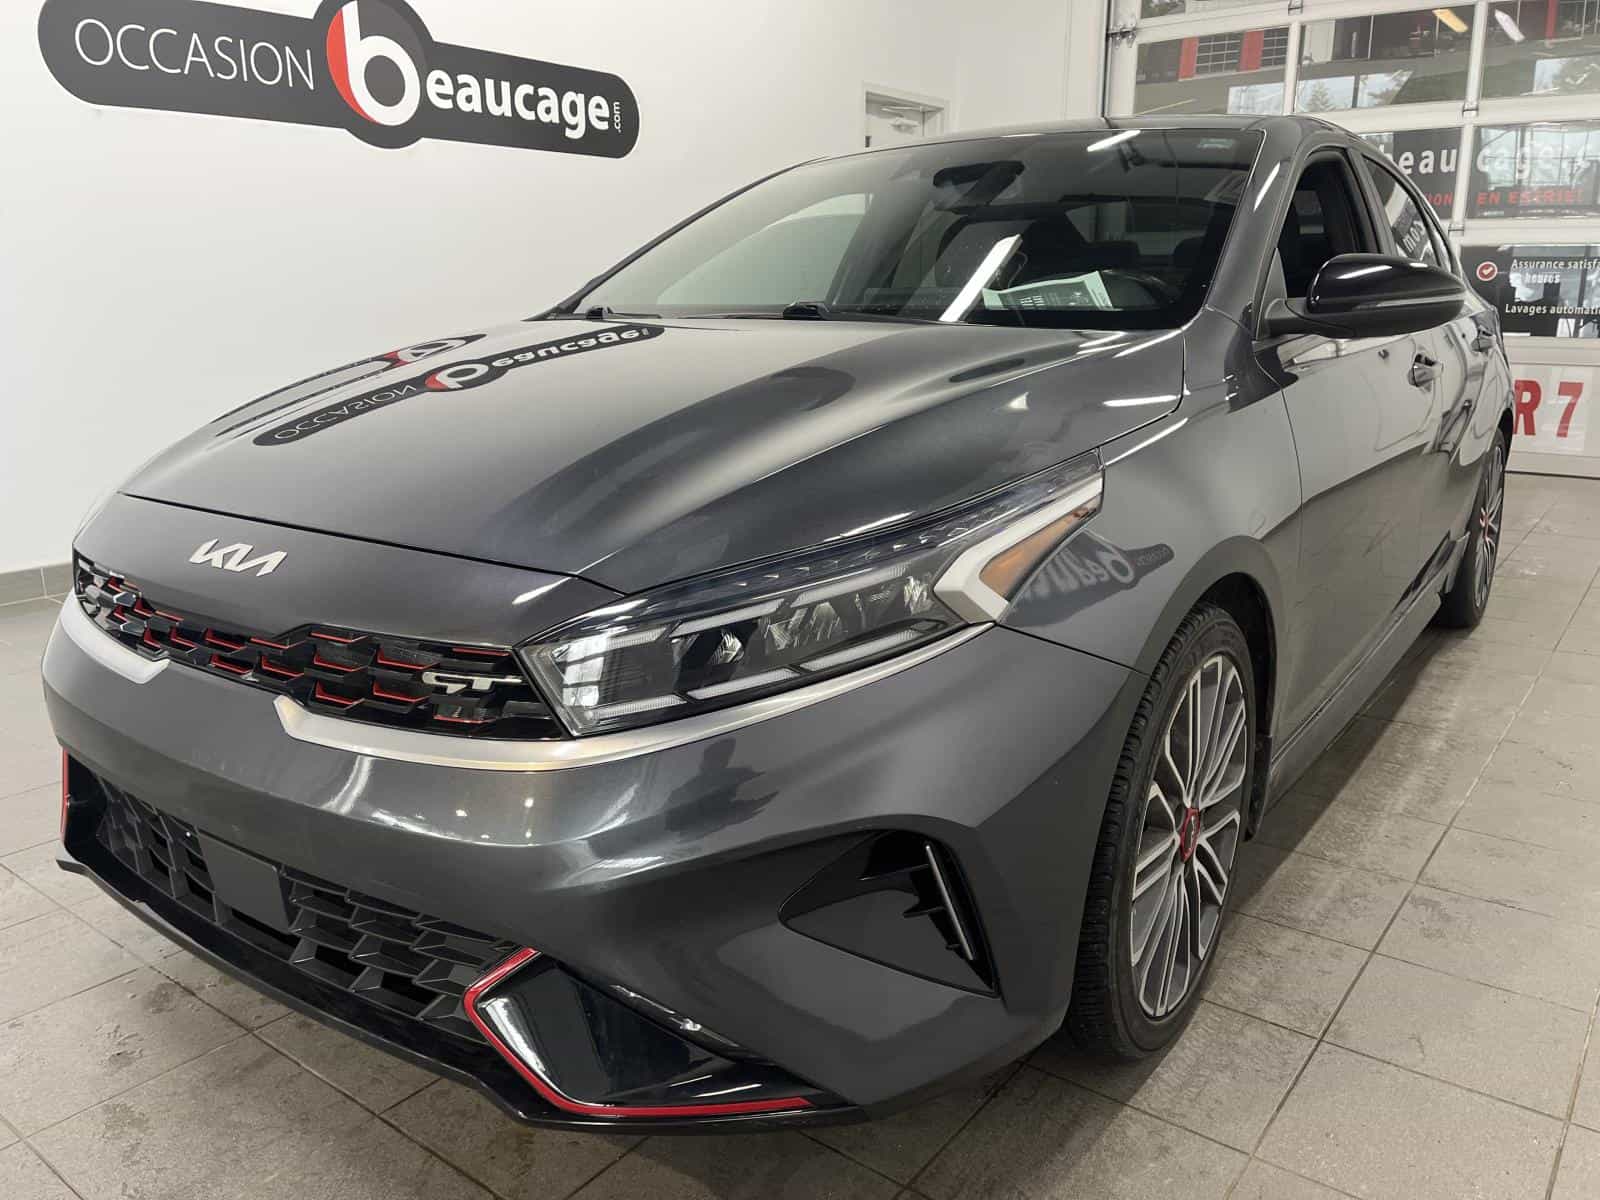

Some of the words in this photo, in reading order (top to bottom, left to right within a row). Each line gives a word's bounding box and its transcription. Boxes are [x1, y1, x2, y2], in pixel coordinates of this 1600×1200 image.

[74, 18, 315, 91] OCCASION
[1511, 258, 1565, 271] Assurance
[1505, 303, 1547, 316] Lavages
[1549, 303, 1600, 315] automati
[1556, 381, 1584, 438] 7
[422, 671, 523, 694] GT
